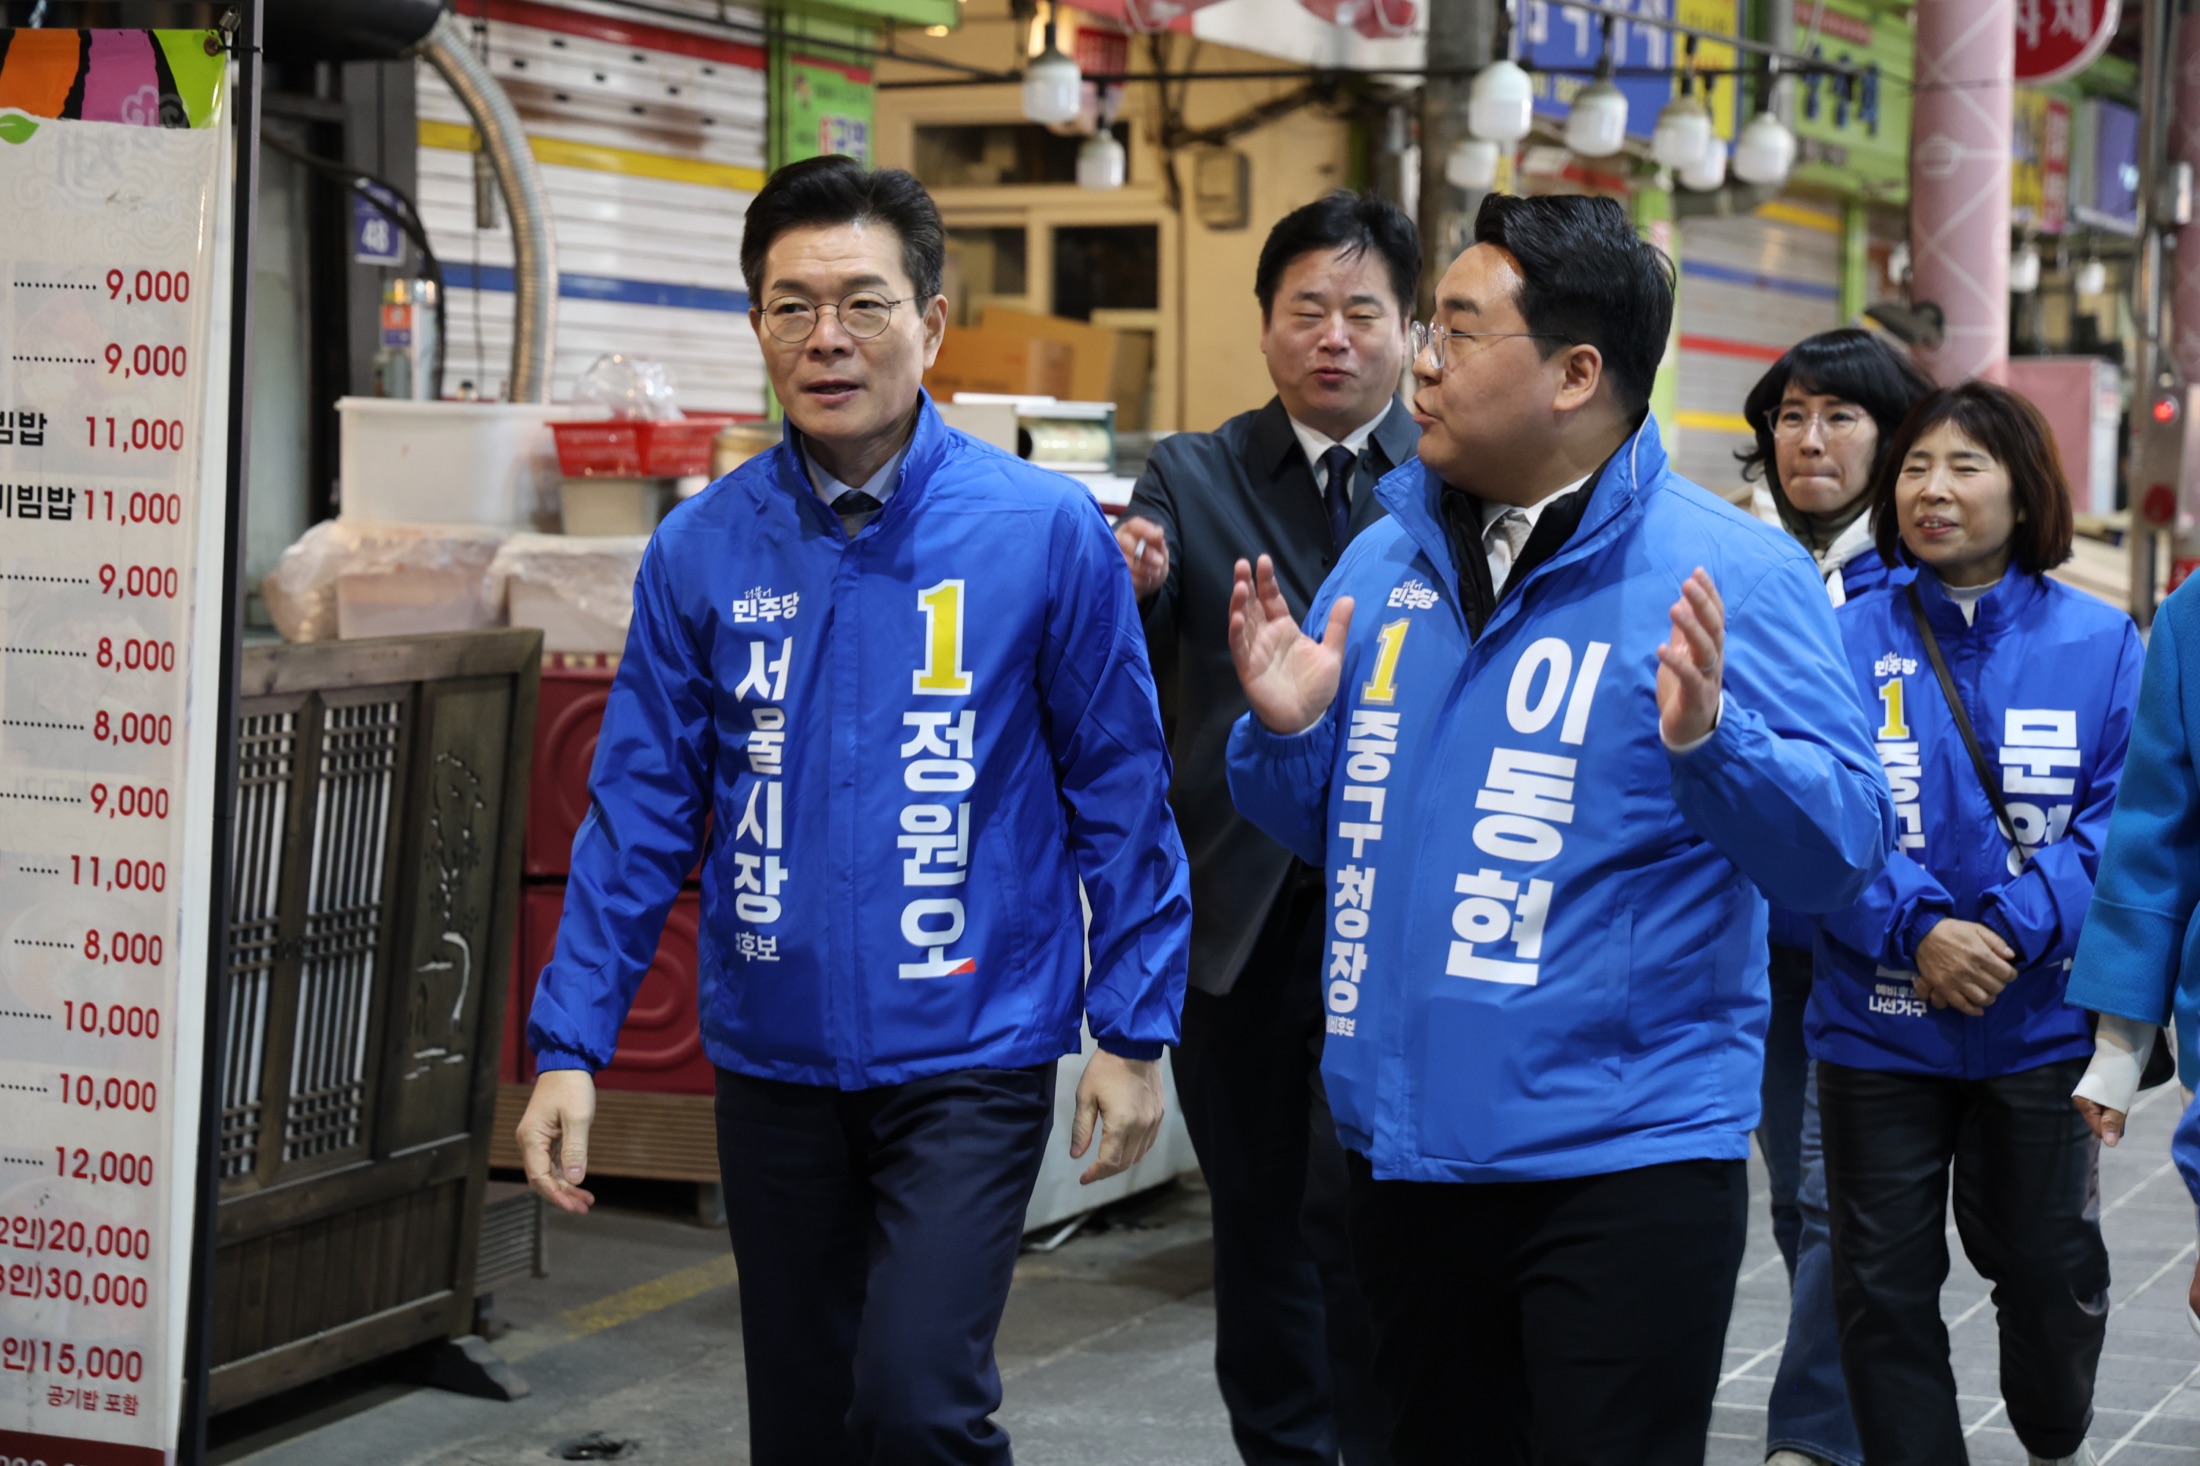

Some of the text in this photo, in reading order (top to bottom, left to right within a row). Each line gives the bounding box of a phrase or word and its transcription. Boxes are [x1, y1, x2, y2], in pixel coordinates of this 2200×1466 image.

[105, 268, 190, 304] 9,000
[103, 342, 187, 378] 9,000
[86, 416, 185, 453] 11,000
[84, 489, 182, 526] 11,000
[98, 563, 179, 599] 9,000
[1386, 586, 1440, 610] 민주당
[732, 591, 800, 623] 민주당
[95, 636, 175, 673] 8,000
[912, 578, 973, 696] 1
[1361, 617, 1411, 706] 1
[1874, 657, 1918, 677] 민주당
[1876, 676, 1910, 740] 1
[93, 709, 172, 746] 8,000
[734, 636, 793, 923] 서울시장
[90, 782, 169, 820] 9,000
[1445, 637, 1611, 986] 이동현
[1874, 741, 1926, 870] 중구
[897, 710, 977, 979] 정원오
[1327, 709, 1401, 1014] 중구청장
[70, 854, 166, 893] 11,000
[83, 928, 163, 967] 8,000
[63, 1000, 160, 1040] 10,000
[1868, 994, 1927, 1017] 나선거구
[59, 1073, 157, 1113] 10,000
[55, 1146, 153, 1187] 12,000
[47, 1385, 139, 1416] 공기밥 포함
